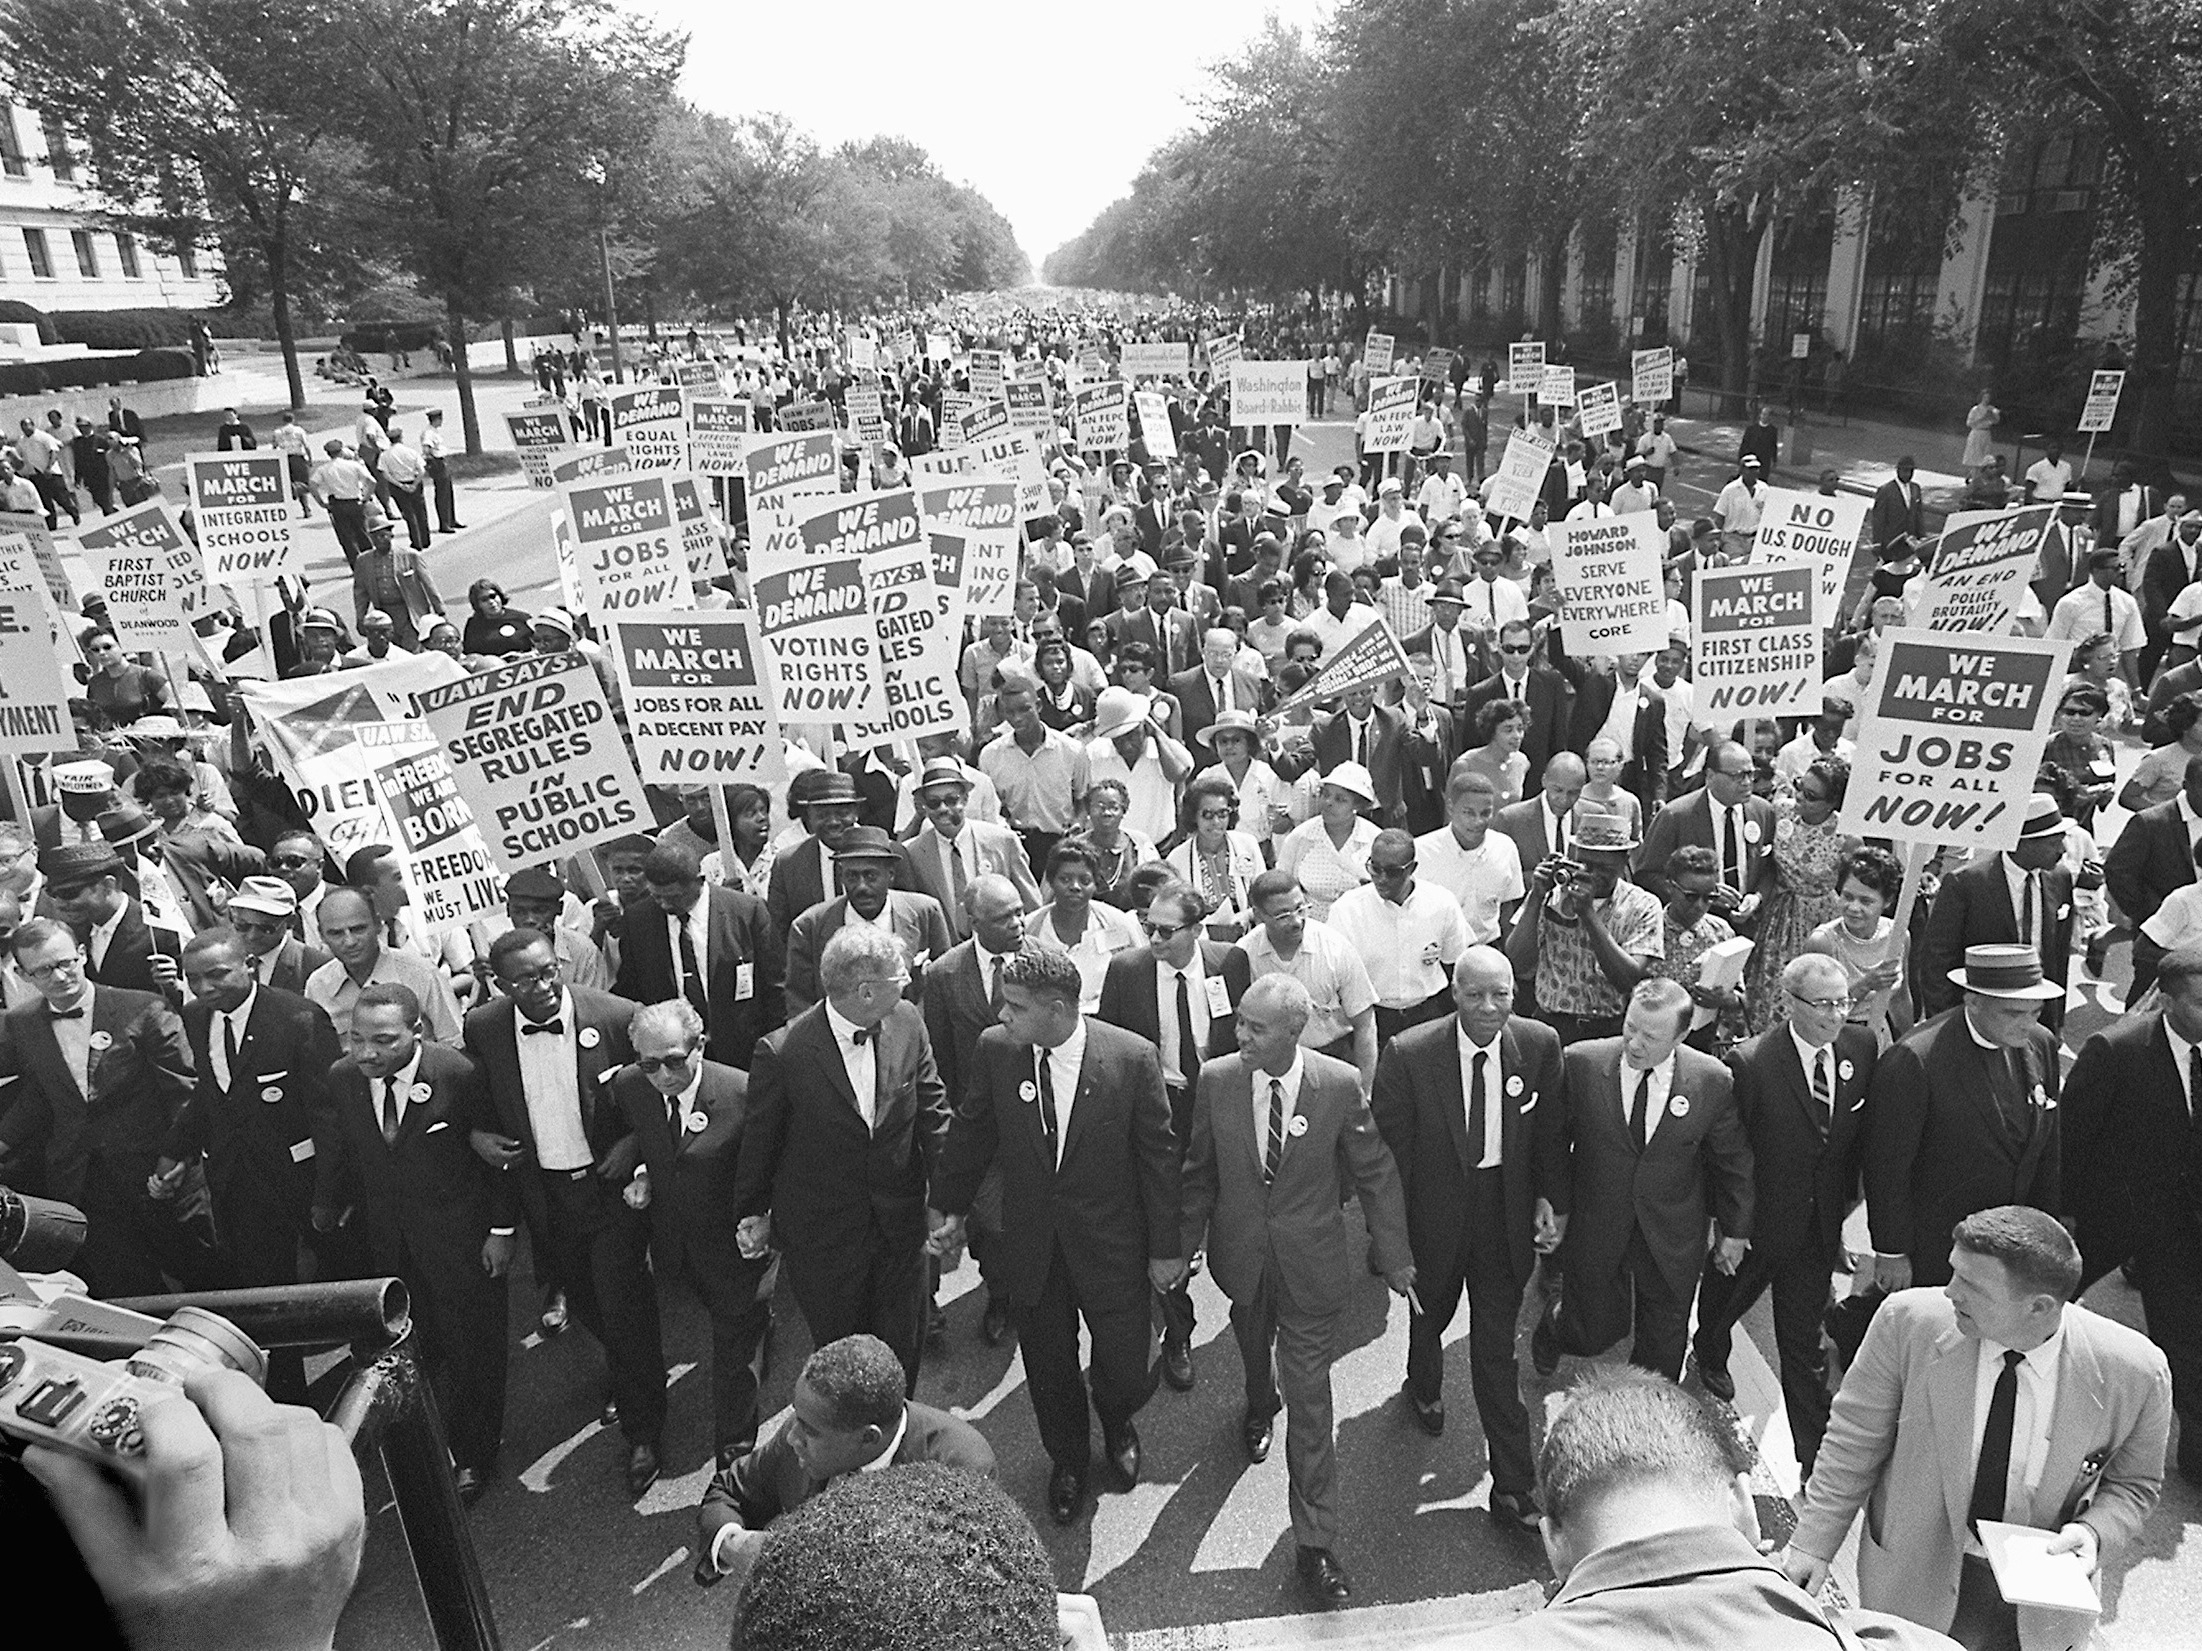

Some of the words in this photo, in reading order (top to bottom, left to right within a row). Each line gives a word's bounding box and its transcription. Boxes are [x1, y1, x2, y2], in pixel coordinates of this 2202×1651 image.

[1237, 377, 1301, 395] Washington
[633, 391, 660, 408] WE
[711, 405, 728, 414] WE
[524, 418, 541, 427] WE
[618, 401, 680, 426] DEMAND
[697, 413, 742, 425] MARCH
[1372, 414, 1386, 422] AN
[515, 426, 560, 438] MARCH
[626, 430, 677, 441] EQUAL
[1380, 423, 1404, 433] LAW
[1085, 432, 1123, 445] NOW!
[1373, 433, 1410, 446] NOW!
[775, 440, 807, 464] WE
[982, 439, 1029, 463] I.U.E.
[223, 463, 250, 477] WE
[578, 454, 604, 473] WE
[700, 460, 743, 471] NOW!
[754, 453, 832, 490] DEMAND
[204, 476, 277, 496] MARCH
[603, 487, 634, 504] WE
[227, 494, 256, 504] FOR
[757, 495, 784, 511] AN
[947, 487, 986, 509] WE
[202, 508, 287, 527] INTEGRATED
[583, 498, 663, 528] MARCH
[837, 502, 879, 534] WE
[1790, 503, 1836, 528] NO
[108, 520, 137, 539] WE
[206, 528, 290, 547] SCHOOLS
[611, 522, 643, 535] FOR
[1567, 525, 1629, 544] HOWARD
[1973, 516, 2019, 544] WE
[1760, 527, 1786, 548] U.S.
[1791, 532, 1851, 557] DOUGH
[1939, 528, 2040, 573] DEMAND
[219, 546, 289, 572] NOW!
[592, 537, 670, 571] JOBS
[109, 558, 154, 571] FIRST
[598, 572, 633, 585] FOR
[642, 564, 671, 577] ALL
[1581, 561, 1627, 579] SERVE
[104, 573, 165, 588] BAPTIST
[788, 567, 827, 597] WE
[1740, 576, 1774, 594] WE
[1940, 572, 1972, 588] AN
[1976, 569, 2017, 584] END
[109, 589, 166, 603] CHURCH
[603, 575, 678, 610] NOW!
[1564, 579, 1652, 602] EVERYONE
[1949, 589, 1997, 605] POLICE
[764, 585, 863, 629] DEMAND
[1562, 599, 1660, 622] EVERYWHERE
[1709, 591, 1804, 618] MARCH
[1932, 602, 2001, 618] BRUTALITY
[120, 619, 179, 629] DEANWOOD
[1589, 623, 1632, 640] CORE
[1738, 615, 1776, 628] FOR
[661, 628, 703, 646] WE
[770, 637, 870, 657] VOTING
[1702, 637, 1753, 657] FIRST
[1759, 633, 1814, 653] CLASS
[634, 648, 743, 670] MARCH
[1353, 655, 1378, 675] JOBS
[1697, 653, 1815, 678] CITIZENSHIP
[1948, 653, 1997, 677] WE
[429, 676, 489, 708] UAW
[497, 654, 579, 689] SAYS:
[670, 674, 714, 684] FOR
[781, 662, 868, 682] RIGHTS
[783, 683, 871, 710] NOW!
[1710, 677, 1807, 709] NOW!
[1893, 674, 2034, 709] MARCH
[465, 682, 566, 731] END
[634, 698, 681, 713] JOBS
[685, 698, 723, 712] FOR
[729, 696, 764, 711] ALL
[1931, 706, 1985, 724] FOR
[363, 724, 406, 747] UAW
[448, 700, 603, 764] SEGREGATED
[638, 722, 653, 736] A
[654, 722, 723, 736] DECENT
[729, 720, 766, 735] PAY
[479, 732, 592, 784] RULES
[660, 744, 765, 772] NOW!
[1879, 734, 2015, 772] JOBS
[1879, 770, 1934, 788] FOR
[1950, 778, 2000, 793] ALL
[409, 787, 433, 808] WE
[496, 774, 621, 831] PUBLIC
[1863, 795, 2007, 832] NOW!
[502, 799, 636, 859] SCHOOLS
[424, 890, 444, 905] WE
[423, 901, 463, 924] MUST
